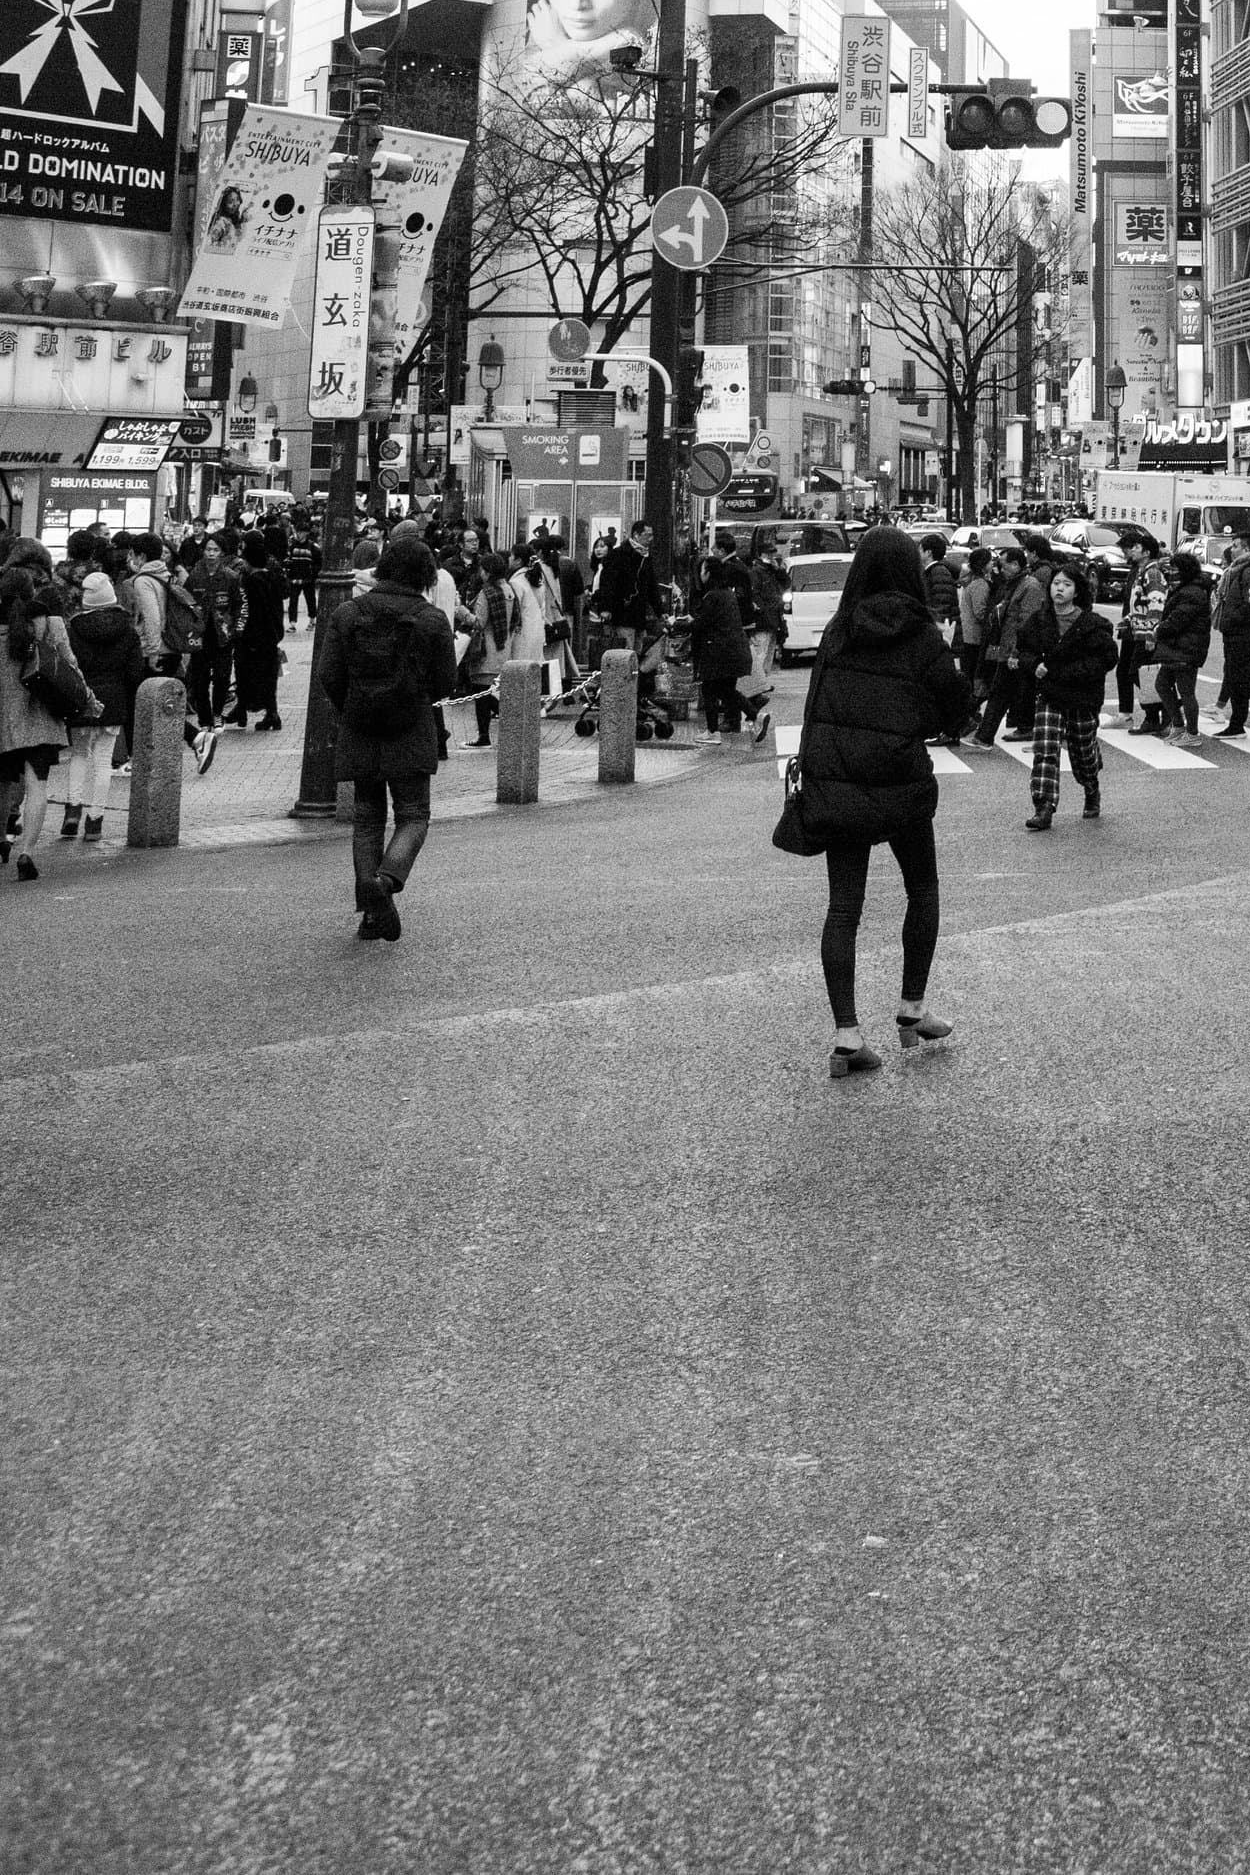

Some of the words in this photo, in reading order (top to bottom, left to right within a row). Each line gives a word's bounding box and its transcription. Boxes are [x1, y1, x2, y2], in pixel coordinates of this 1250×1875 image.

[229, 36, 249, 57] 薬
[845, 40, 859, 87] Shibuya
[860, 25, 885, 128] 渋谷駅前
[911, 51, 926, 135] スクランブル式
[1074, 70, 1087, 125] KiYoshi
[245, 141, 311, 167] SHIBUYA
[28, 153, 166, 190] DOMINATION
[1074, 127, 1088, 215] Matsumoto
[31, 186, 65, 210] ON
[71, 191, 126, 217] SALE
[255, 224, 299, 241] イチナナ
[1126, 207, 1165, 242] 薬
[351, 226, 369, 329] Dougen-zaka
[1071, 270, 1089, 286] 薬
[317, 227, 353, 397] 道玄坂
[187, 352, 213, 361] OPEN
[183, 426, 209, 436] ガスト
[522, 434, 569, 445] SMOKING
[544, 444, 569, 455] AREA
[51, 477, 90, 489] SHIBUYA
[92, 478, 124, 489] EKIMAE
